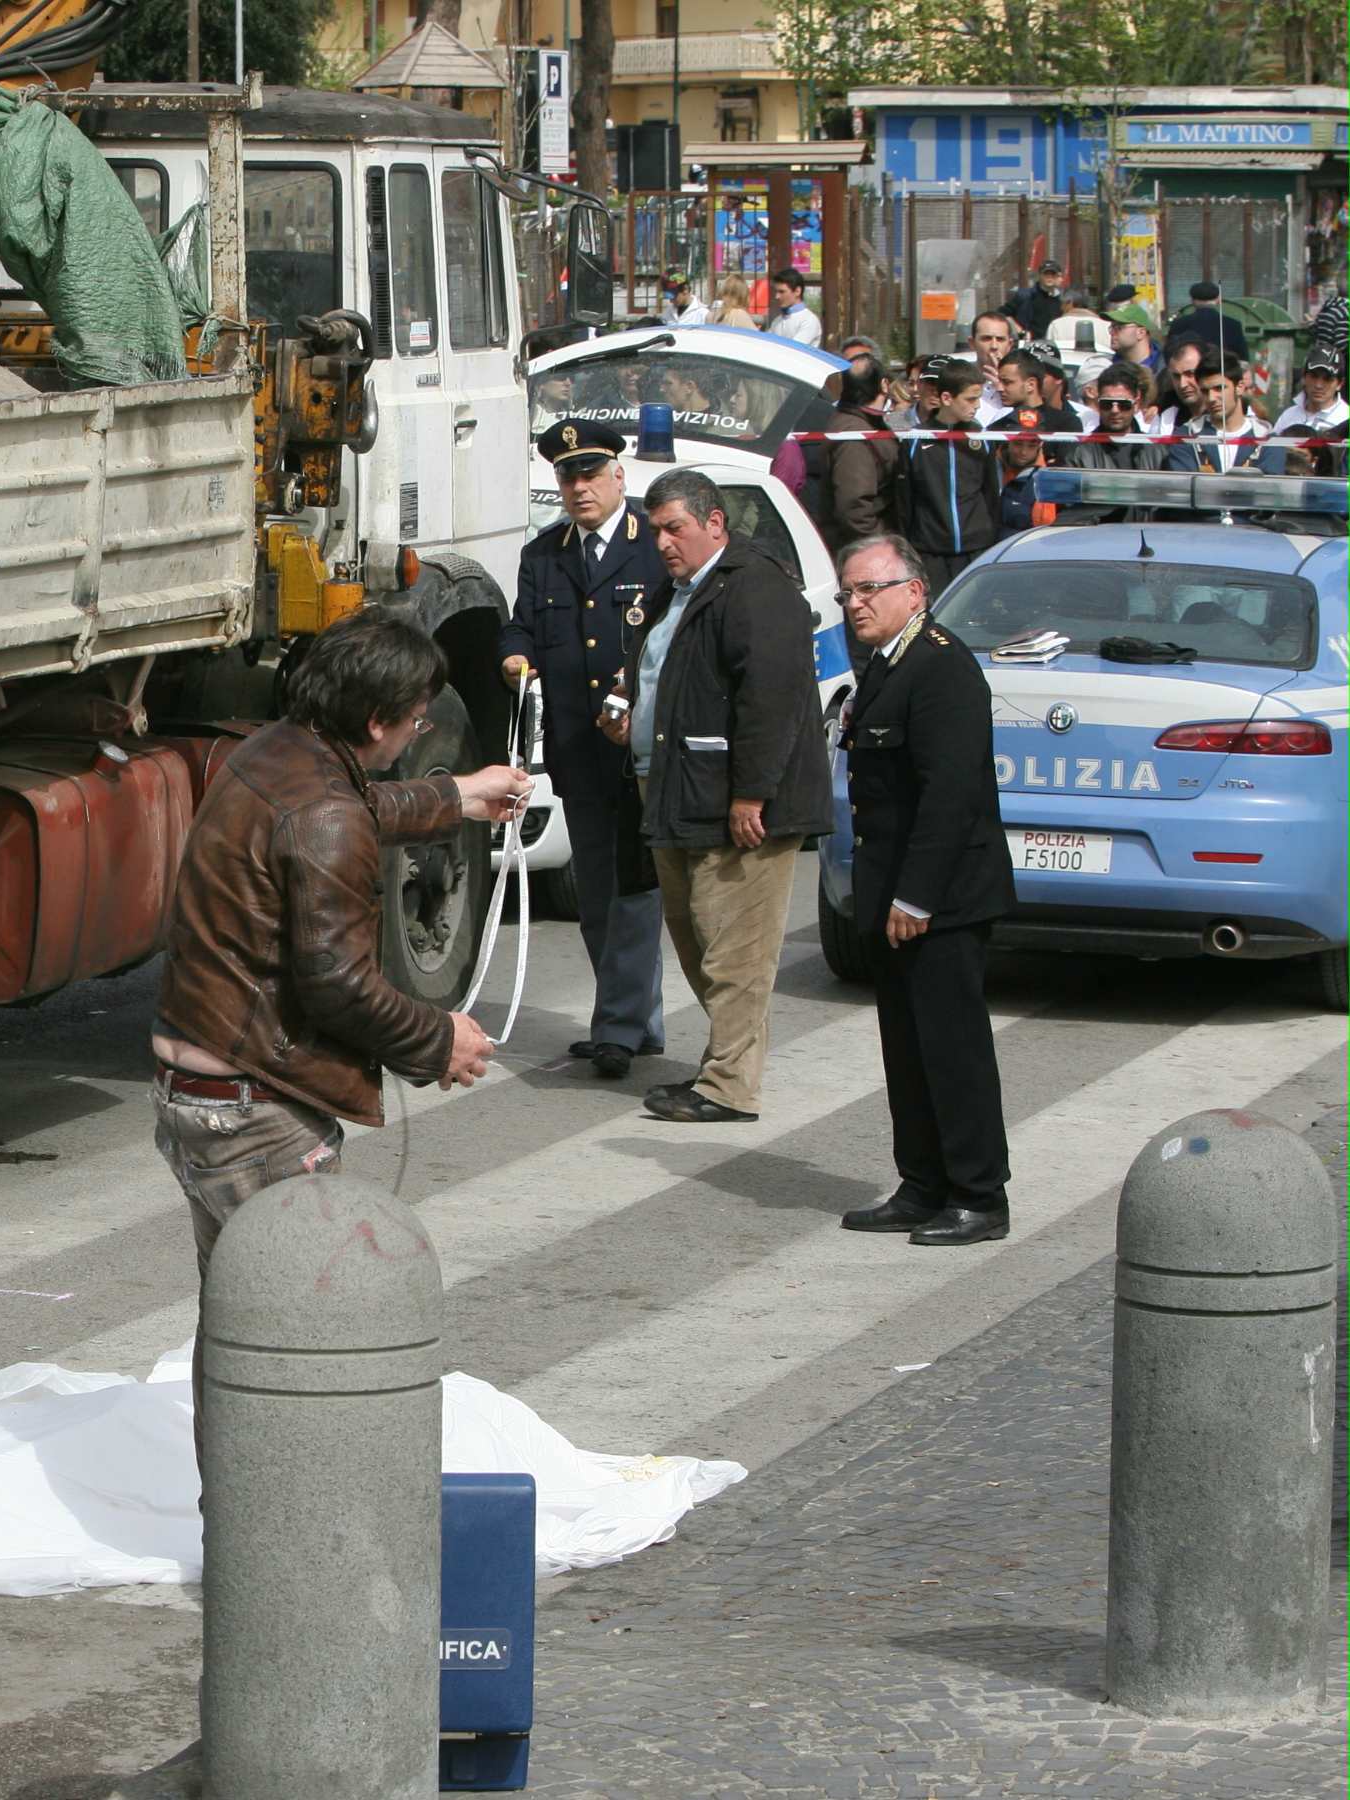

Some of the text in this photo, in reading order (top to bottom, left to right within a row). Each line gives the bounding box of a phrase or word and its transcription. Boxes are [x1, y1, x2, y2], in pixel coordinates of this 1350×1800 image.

[550, 65, 559, 92] P
[1177, 124, 1294, 144] MATTINO
[672, 409, 750, 432] POLIZIA
[1024, 832, 1086, 848] POLIZIA
[1024, 848, 1082, 870] F5100
